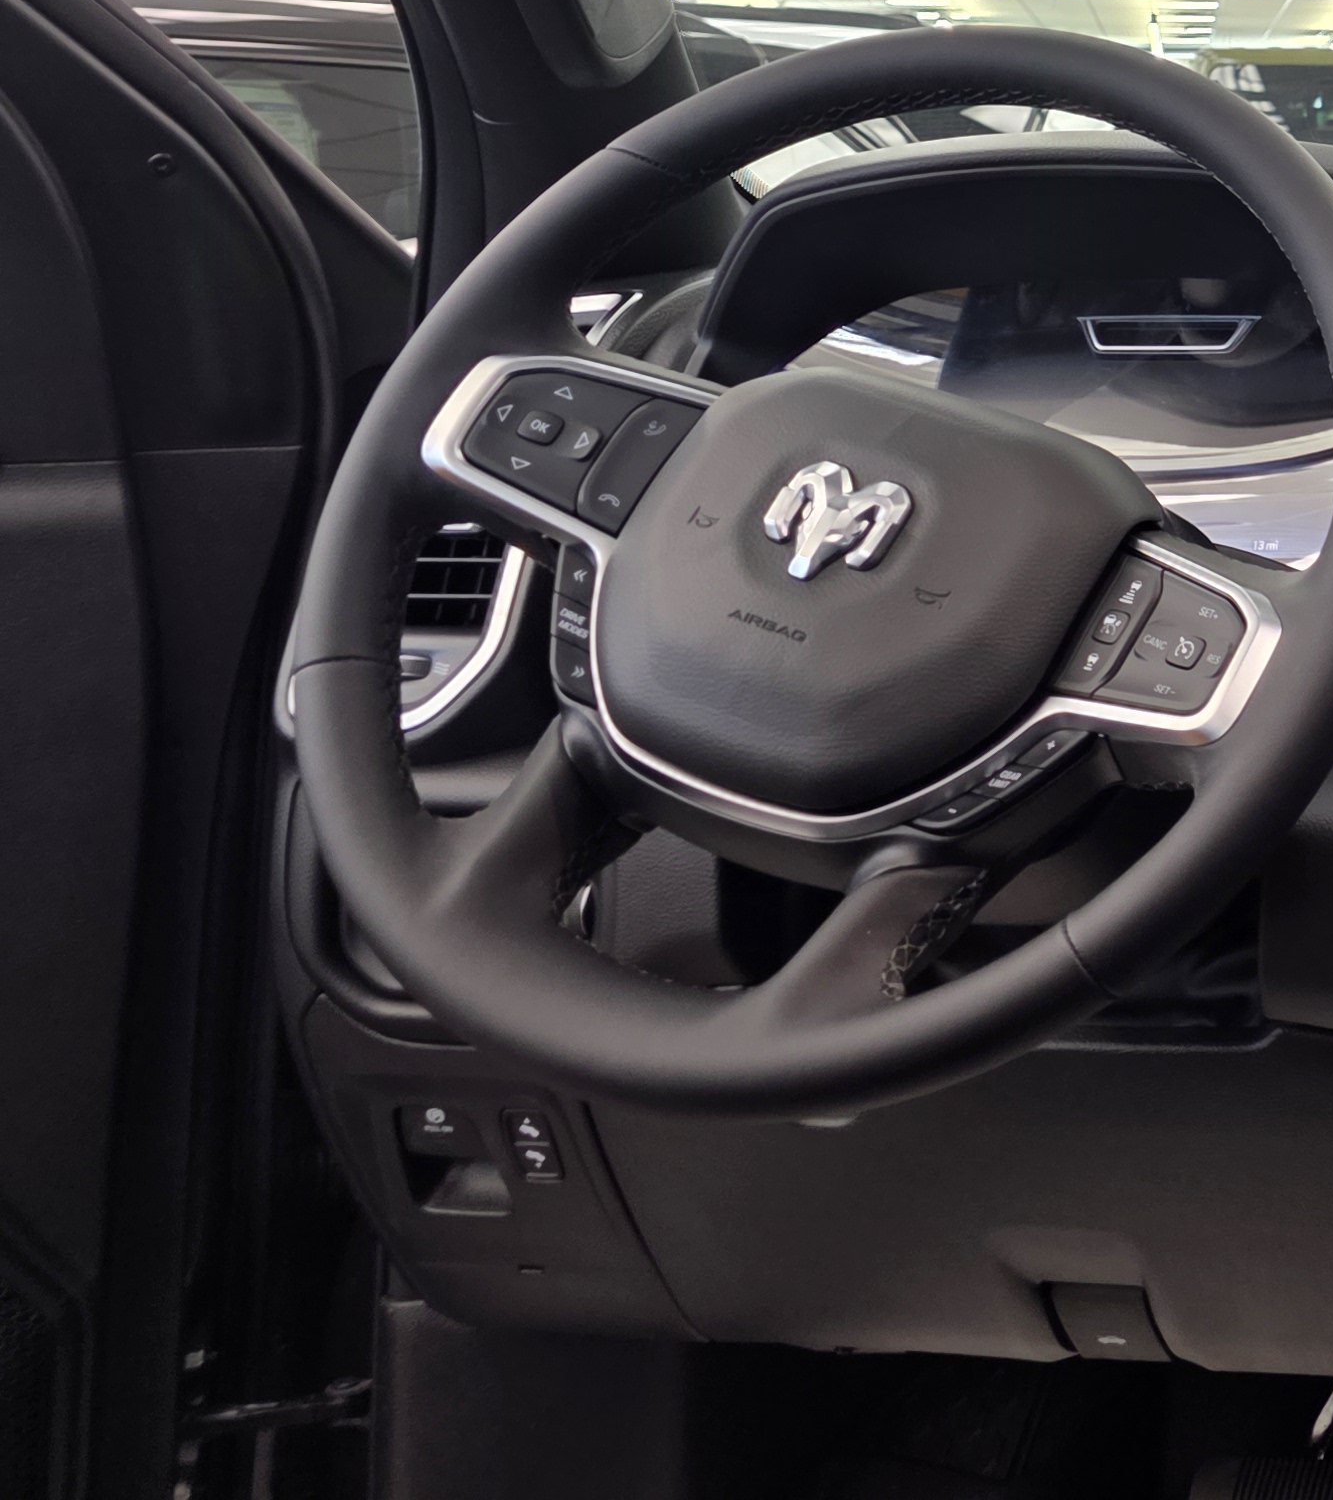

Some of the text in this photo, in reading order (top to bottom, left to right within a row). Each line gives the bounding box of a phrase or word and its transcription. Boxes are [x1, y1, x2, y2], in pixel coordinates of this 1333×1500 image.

[530, 419, 551, 434] OK
[1253, 540, 1279, 550] 13 mi
[728, 609, 807, 642] AIRBAG
